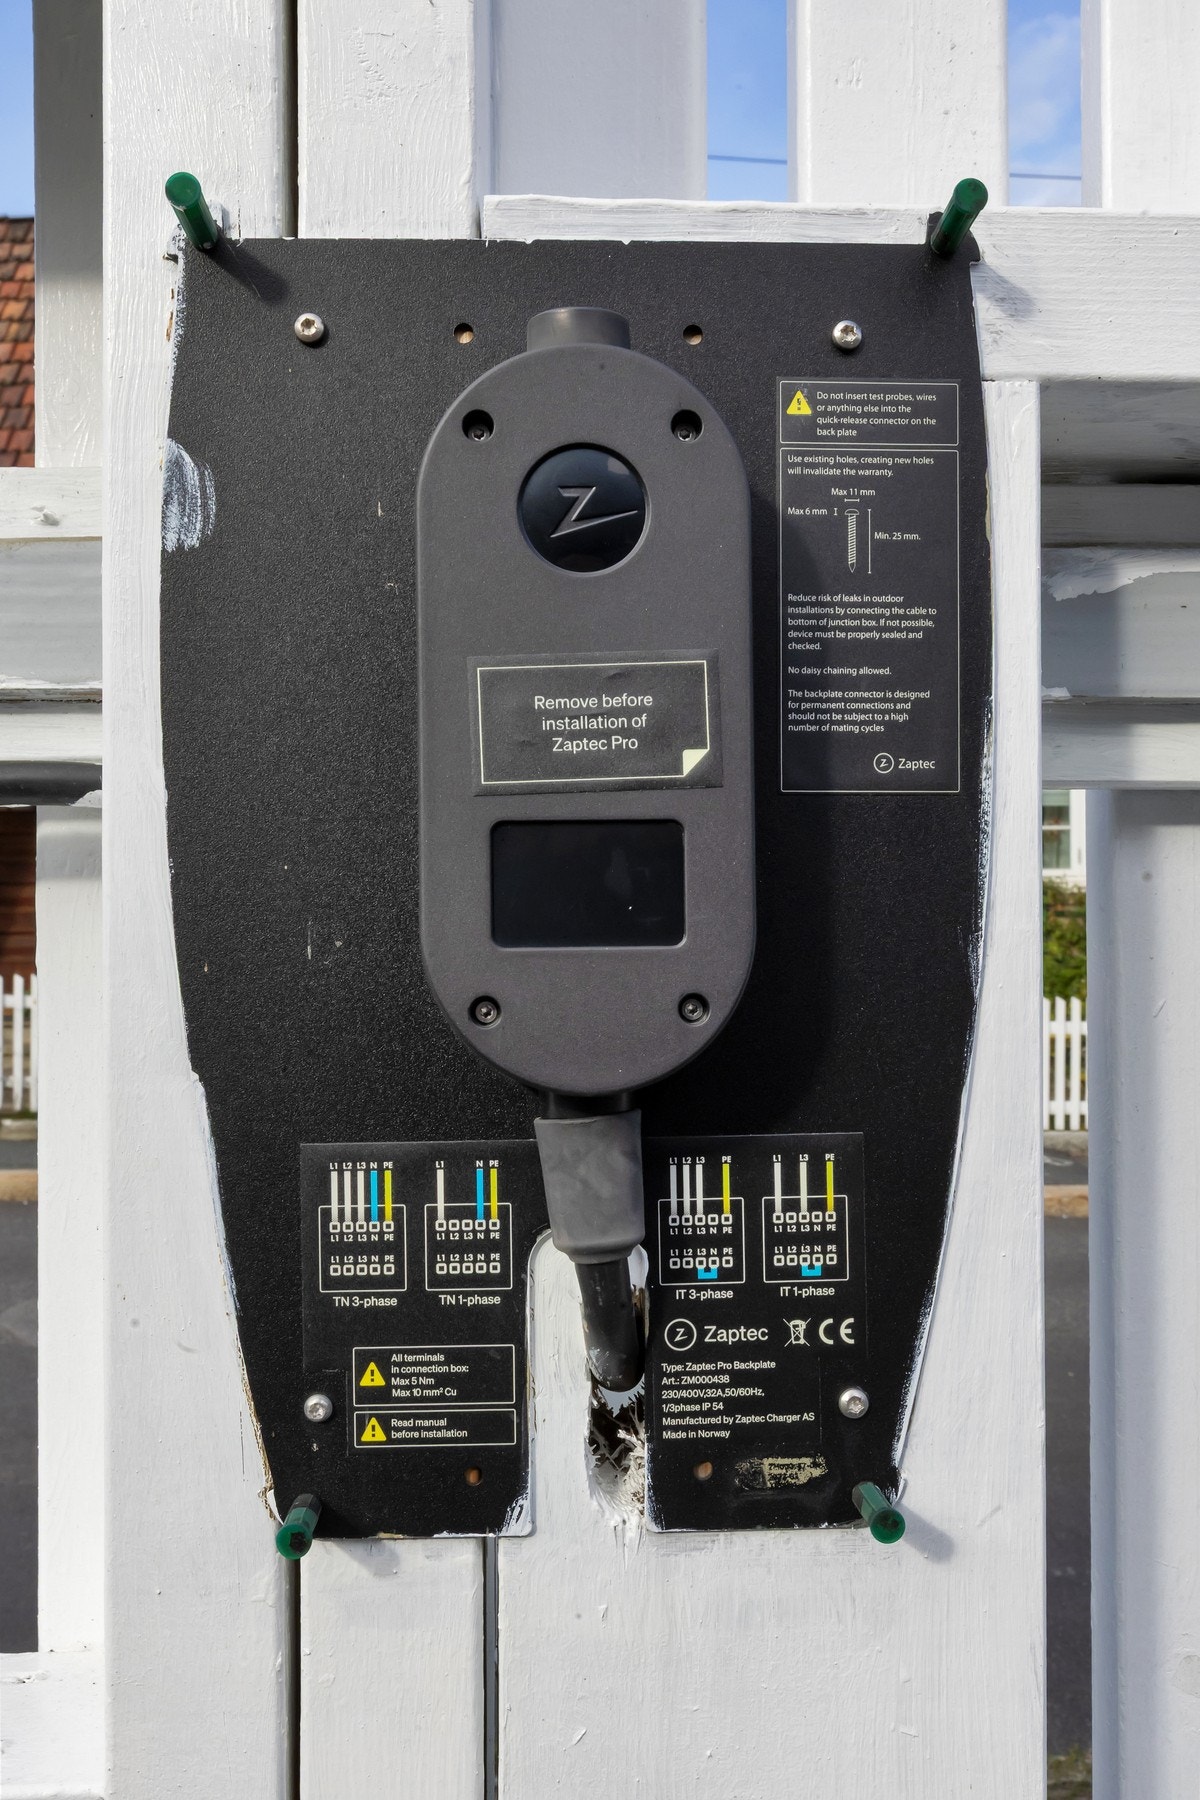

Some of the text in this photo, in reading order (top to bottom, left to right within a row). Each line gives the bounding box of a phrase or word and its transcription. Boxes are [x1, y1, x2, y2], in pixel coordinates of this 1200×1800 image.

[817, 391, 829, 400] Do
[845, 392, 867, 400] insert
[885, 392, 914, 402] probes,
[916, 393, 937, 401] wires
[827, 404, 862, 414] anything
[863, 404, 879, 412] else
[881, 405, 897, 413] into
[898, 404, 911, 413] the
[816, 415, 868, 425] quick-release
[923, 417, 936, 425] the
[817, 427, 857, 437] back plate
[787, 454, 802, 463] Use
[803, 455, 834, 465] existing
[836, 455, 859, 464] holes,
[860, 456, 893, 466] creating
[913, 456, 934, 464] holes
[787, 466, 893, 478] will invalidate the warranty.
[831, 487, 847, 496] Max
[788, 507, 804, 515] Max
[805, 507, 811, 515] 6
[874, 531, 891, 539] Min.
[892, 532, 902, 540] 25
[788, 593, 904, 603] Reduce risk of leaks in outdoor
[788, 606, 834, 614] installations
[835, 606, 845, 616] by
[846, 606, 890, 616] connecting
[891, 606, 905, 615] the
[906, 606, 927, 615] cable
[788, 618, 935, 628] bottom of junction box. If not possible,
[788, 630, 813, 638] device
[836, 630, 846, 638] be
[847, 630, 880, 640] properly
[881, 630, 906, 639] sealed
[907, 630, 923, 639] and
[788, 642, 822, 650] checked.
[788, 666, 892, 676] No daisy chaining allowed.
[788, 689, 803, 697] The
[804, 689, 843, 699] backplate
[886, 690, 893, 698] is
[893, 690, 930, 700] designed
[534, 693, 653, 710] Remove before
[788, 701, 911, 710] for permanent connections and
[542, 713, 647, 730] installation of
[788, 712, 815, 720] should
[832, 712, 843, 721] be
[844, 712, 873, 722] subject
[874, 713, 883, 721] to
[891, 712, 909, 723] high
[788, 723, 885, 734] number of mating cycles
[552, 735, 638, 754] Zaptec Pro
[898, 758, 935, 771] Zaptec
[682, 1156, 692, 1164] L2
[696, 1156, 705, 1164] L3
[722, 1155, 732, 1163] PE
[330, 1162, 338, 1170] L1
[343, 1162, 352, 1170] L2
[383, 1161, 393, 1169] PE
[676, 1288, 734, 1301] IT 3-phase
[780, 1286, 835, 1298] IT 1-phase
[332, 1296, 398, 1308] TN 3-phase
[438, 1294, 501, 1307] TN 1-phase
[704, 1325, 768, 1345] Zaptec
[818, 1318, 855, 1345] CE
[391, 1353, 445, 1362] All terminals
[391, 1364, 469, 1374] in connection box:
[661, 1360, 776, 1373] Type: Zaptec Pro Backplate
[391, 1376, 435, 1385] Max 5 Nm
[661, 1375, 730, 1385] Art.: ZM000438
[392, 1387, 457, 1397] Max 10 mm² Cu
[662, 1387, 765, 1399] 230/400V,32A,50/60Hz,
[662, 1402, 724, 1413] 1/3phase IP 54
[391, 1417, 447, 1427] Read manual
[662, 1412, 815, 1426] Manufactured by Zaptec Charger AS
[391, 1429, 468, 1439] before installation
[663, 1429, 731, 1439] Made in Norway
